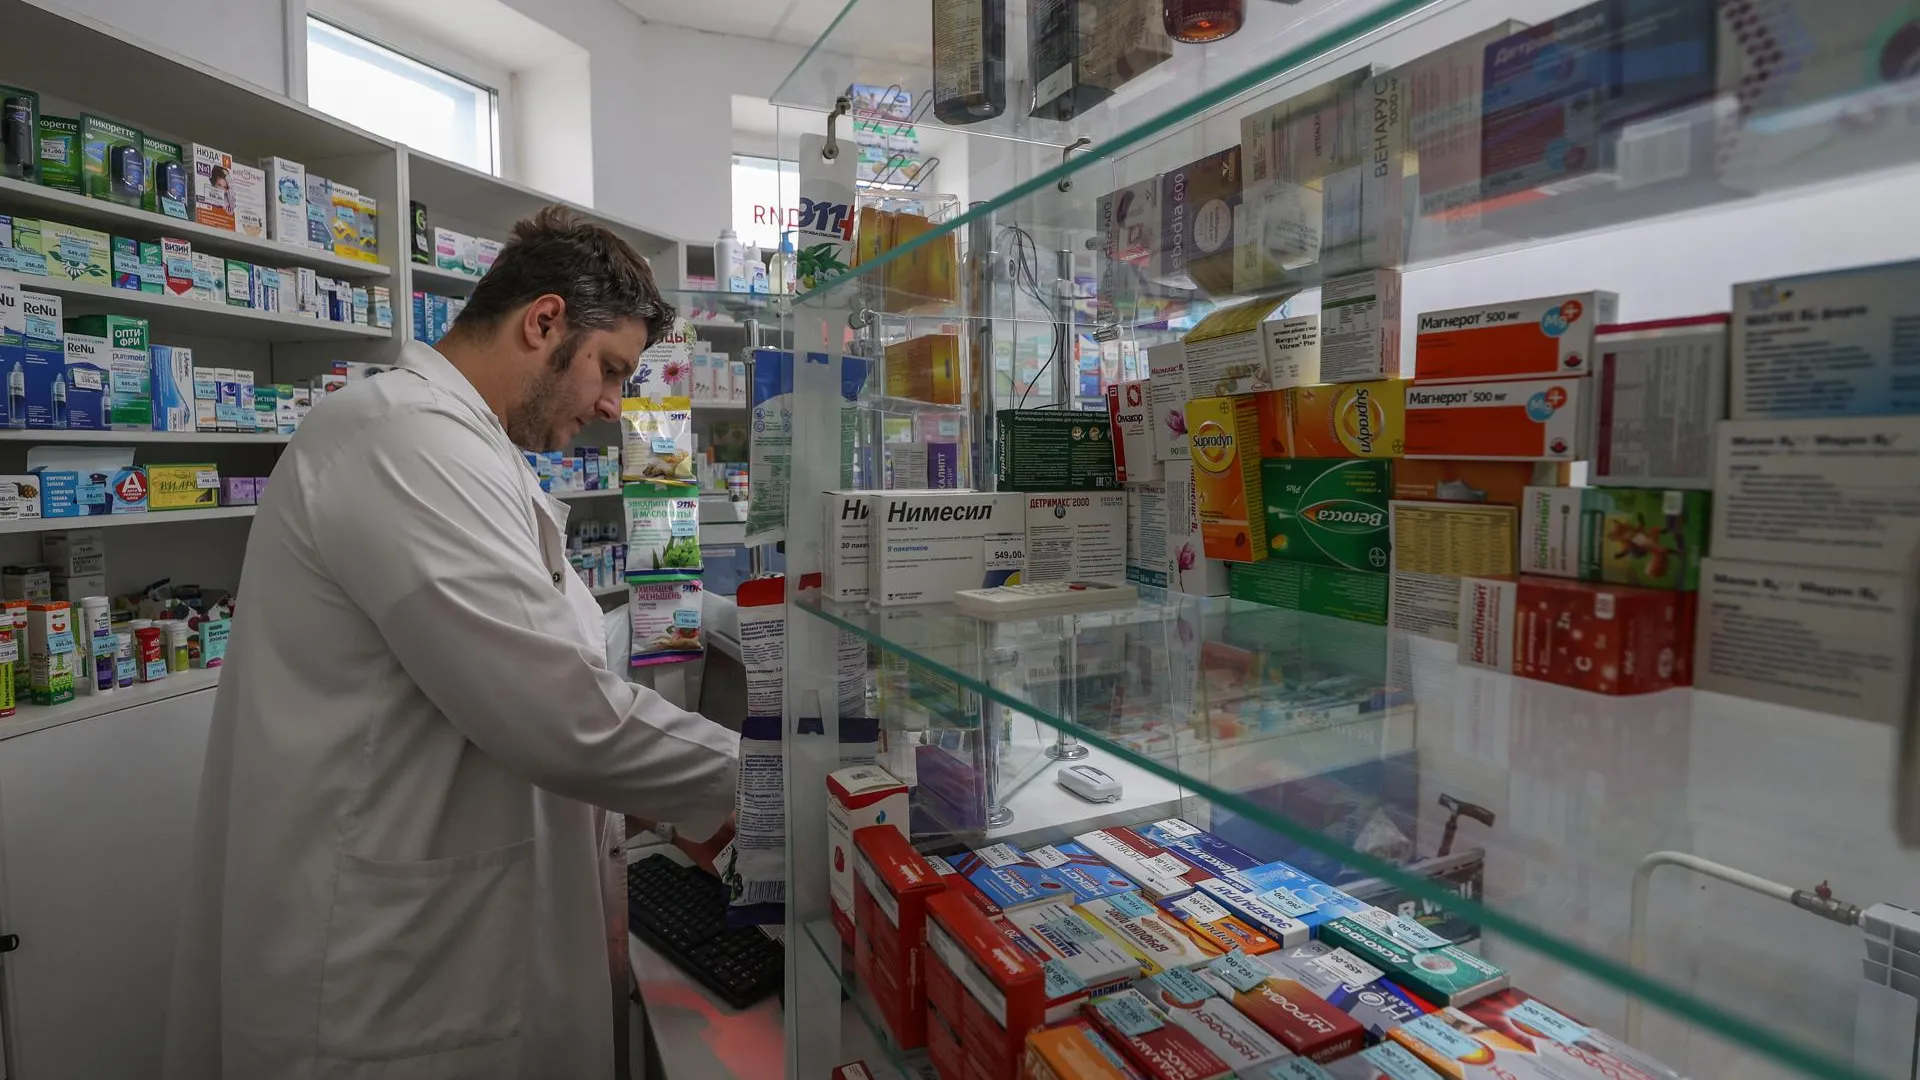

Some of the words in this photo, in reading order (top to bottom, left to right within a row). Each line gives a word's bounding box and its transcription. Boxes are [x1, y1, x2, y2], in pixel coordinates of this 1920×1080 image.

[89, 117, 136, 139] никоретте
[1374, 78, 1388, 178] ВЕНАРУС
[196, 146, 221, 163] НЮДА
[1173, 173, 1185, 201] 600
[165, 242, 189, 254] ВИЗИН
[23, 302, 57, 317] ReNu
[1420, 311, 1482, 331] Магнерот
[1485, 310, 1506, 322] 500
[1507, 310, 1522, 320] мг
[114, 328, 143, 338] ОПТИ-
[67, 342, 95, 354] ReNu
[119, 338, 140, 347] ФРИ
[1409, 391, 1468, 406] Магнерот
[1473, 390, 1493, 402] 500
[1493, 391, 1508, 402] мг
[1116, 412, 1143, 425] Омакор
[1357, 388, 1371, 453] Supradyn
[1192, 433, 1233, 450] Supradyn
[1285, 484, 1302, 494] Plus
[25, 505, 34, 513] 10
[887, 501, 993, 523] Нимесил
[1029, 498, 1070, 509] ДЕТРИМАКС
[1072, 497, 1090, 507] 2000
[1318, 508, 1383, 527] Berocca
[840, 542, 850, 550] 30
[991, 867, 1035, 899] НЕКСТ
[1059, 866, 1104, 897] НЕКСТ
[1214, 882, 1294, 930] ЭФФЕРАЛГАН
[1033, 923, 1083, 958] МАКСИГАН
[1329, 920, 1409, 965] АСКОФЕН
[1191, 1008, 1261, 1062] НУРОФЕН
